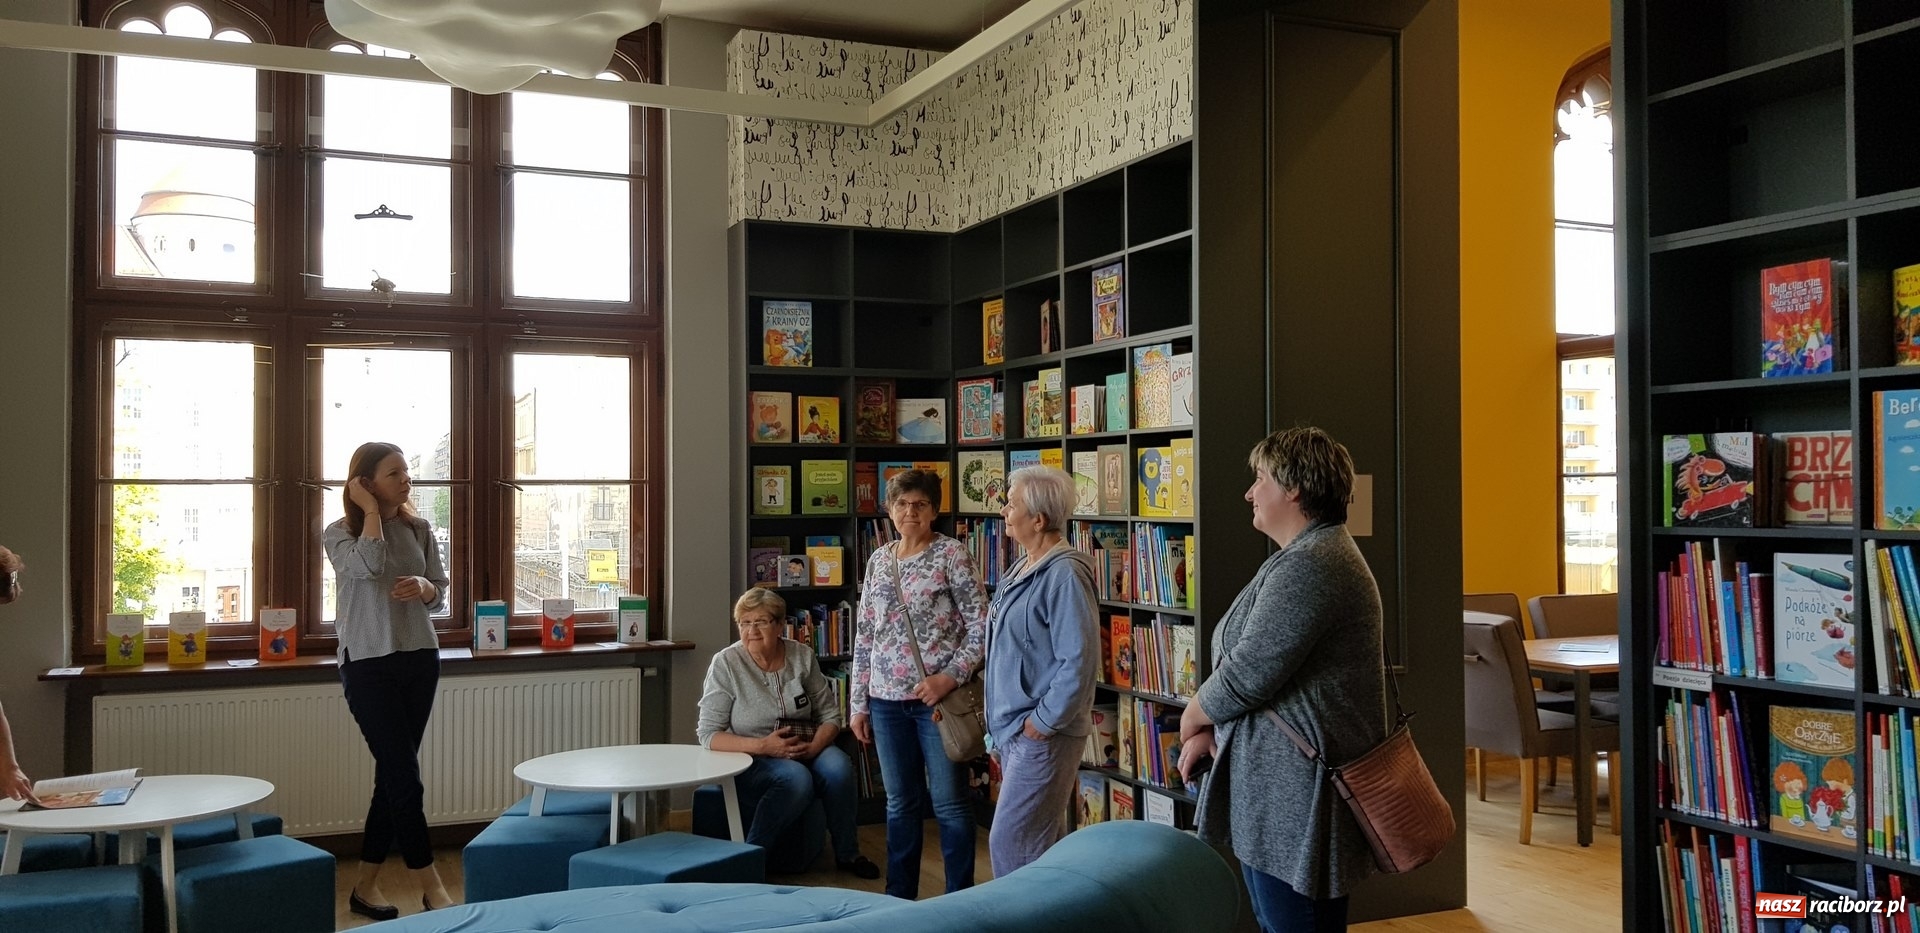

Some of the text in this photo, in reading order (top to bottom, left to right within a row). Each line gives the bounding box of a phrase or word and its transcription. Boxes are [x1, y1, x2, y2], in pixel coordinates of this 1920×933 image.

[772, 316, 798, 327] KRAINY
[799, 317, 810, 326] OZ
[1785, 596, 1828, 614] Podróże
[1795, 616, 1805, 626] na
[1803, 720, 1833, 731] DOBRE
